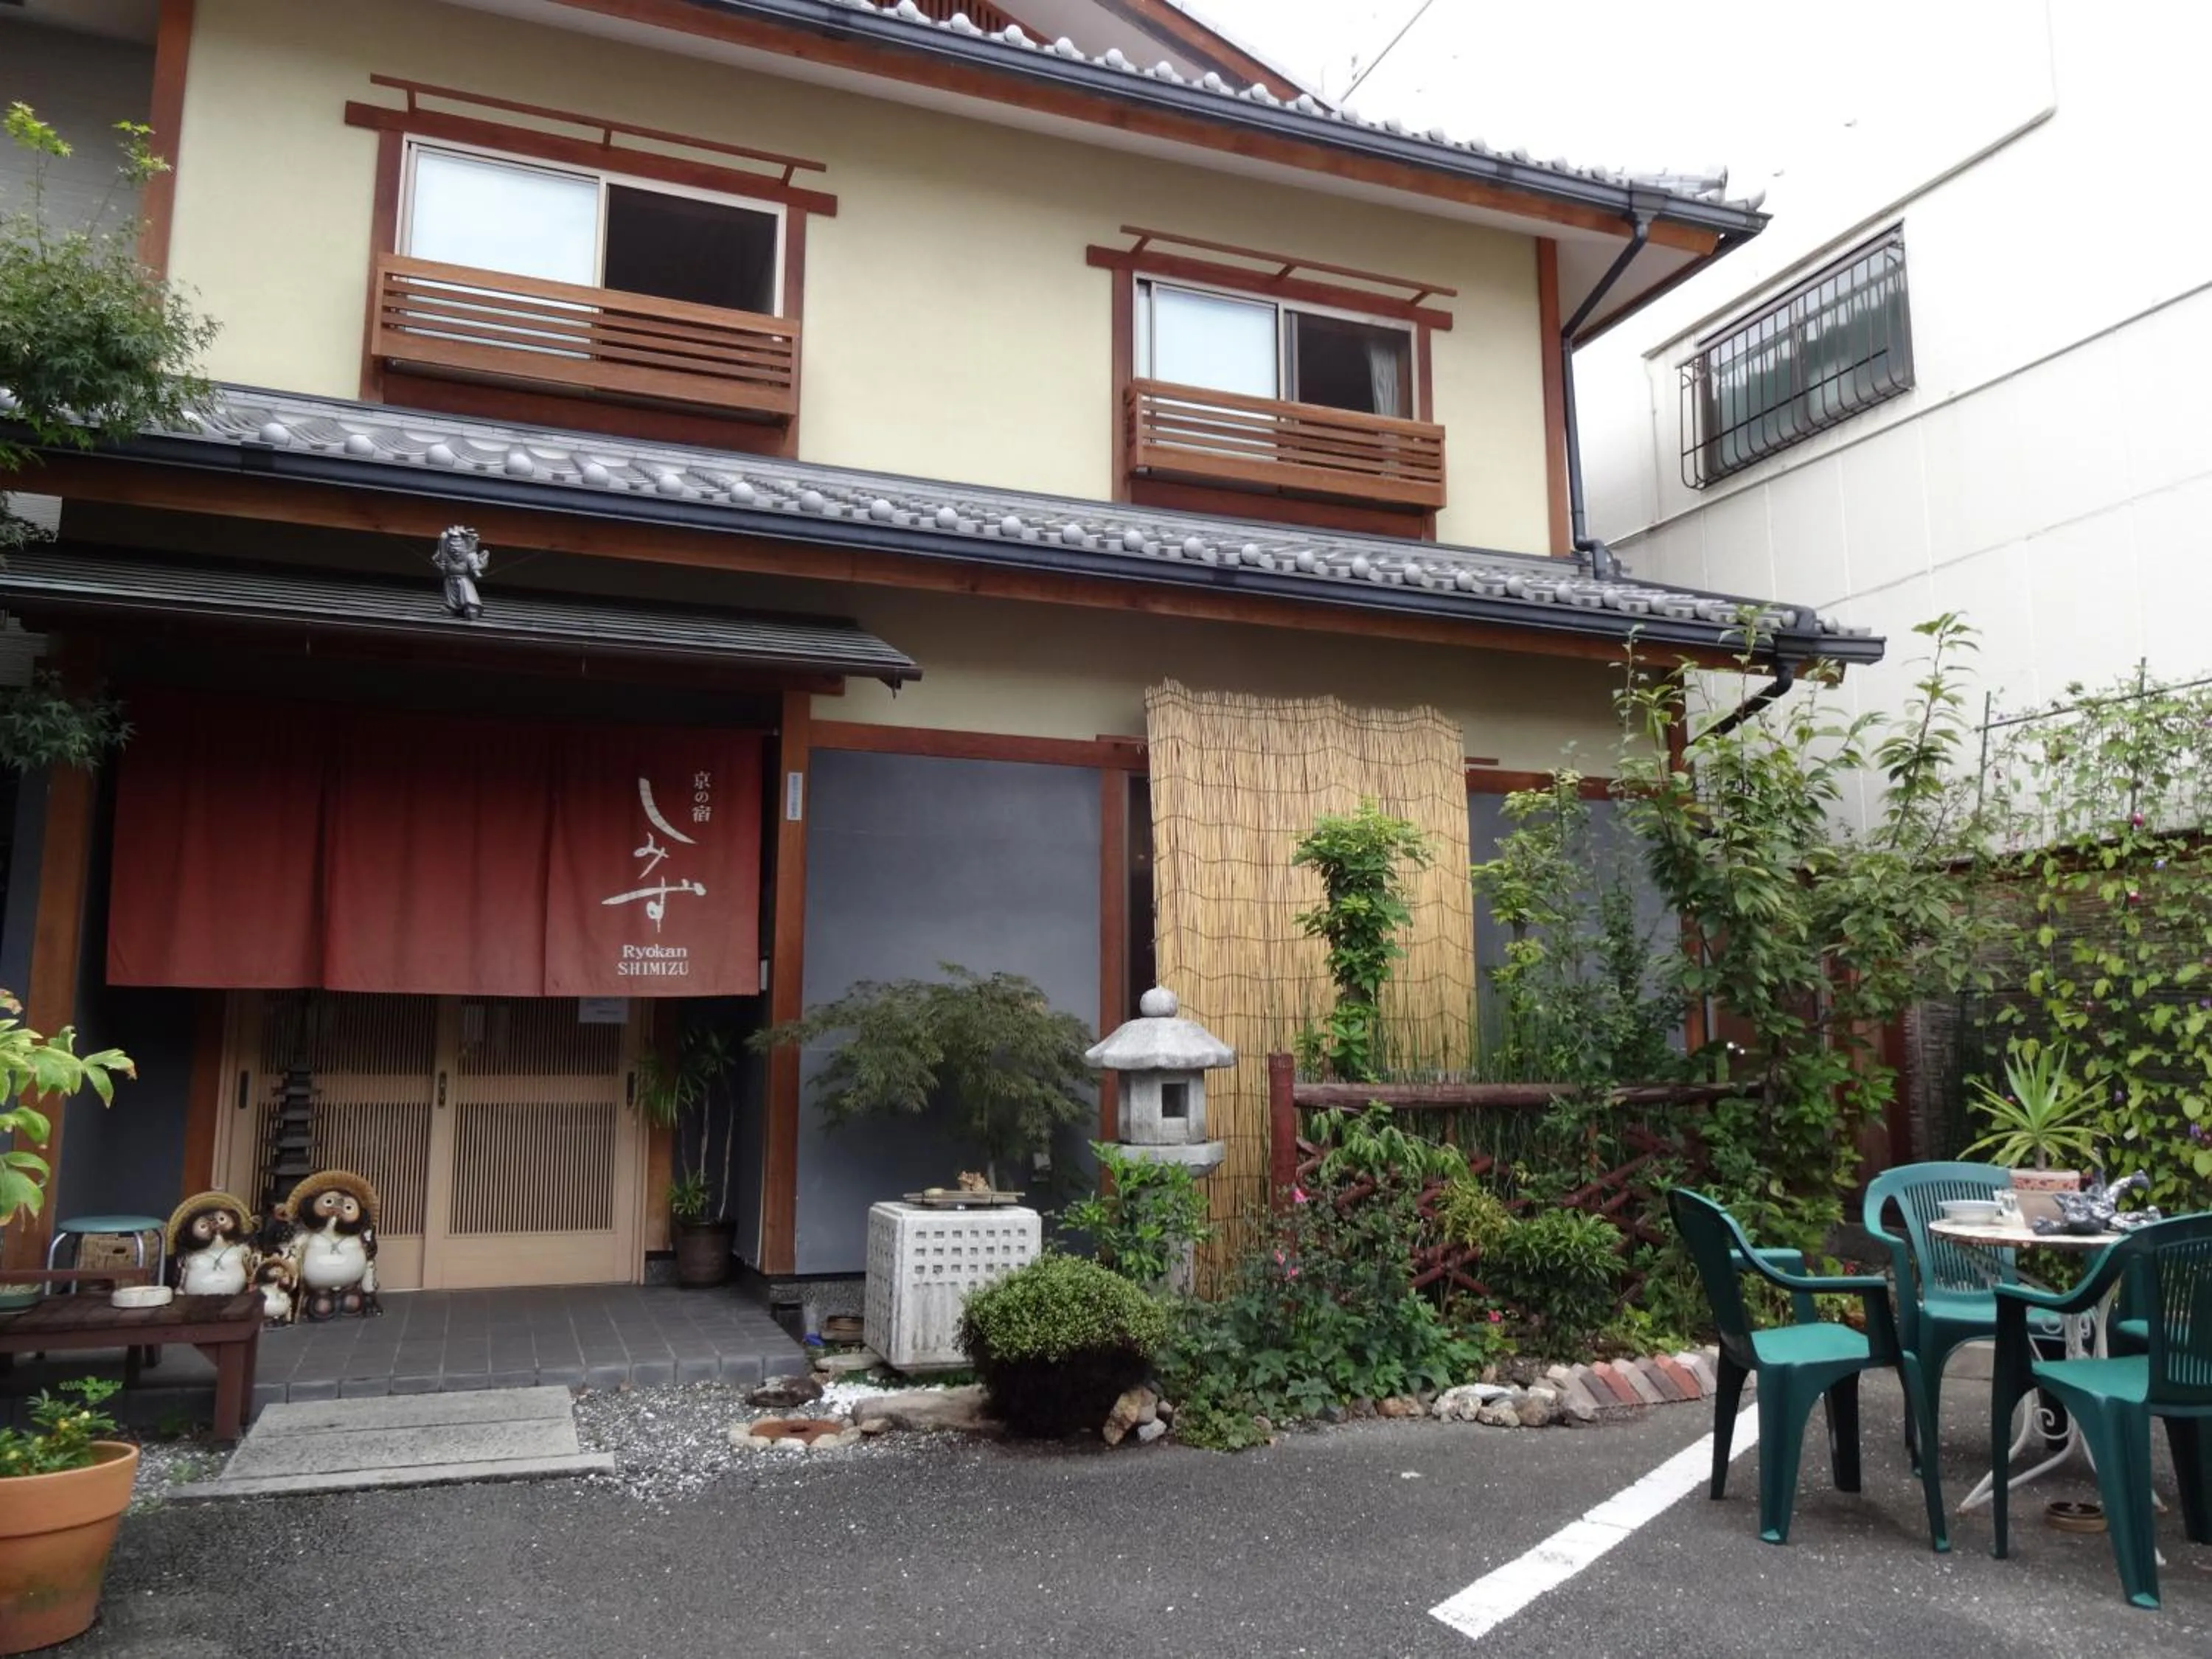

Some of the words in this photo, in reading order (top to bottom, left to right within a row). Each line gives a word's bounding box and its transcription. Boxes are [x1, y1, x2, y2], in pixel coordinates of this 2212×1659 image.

[693, 771, 711, 822] 京の宿
[601, 778, 706, 932] しみず
[617, 961, 689, 975] SHIMIZU
[622, 944, 687, 959] Ryokan
